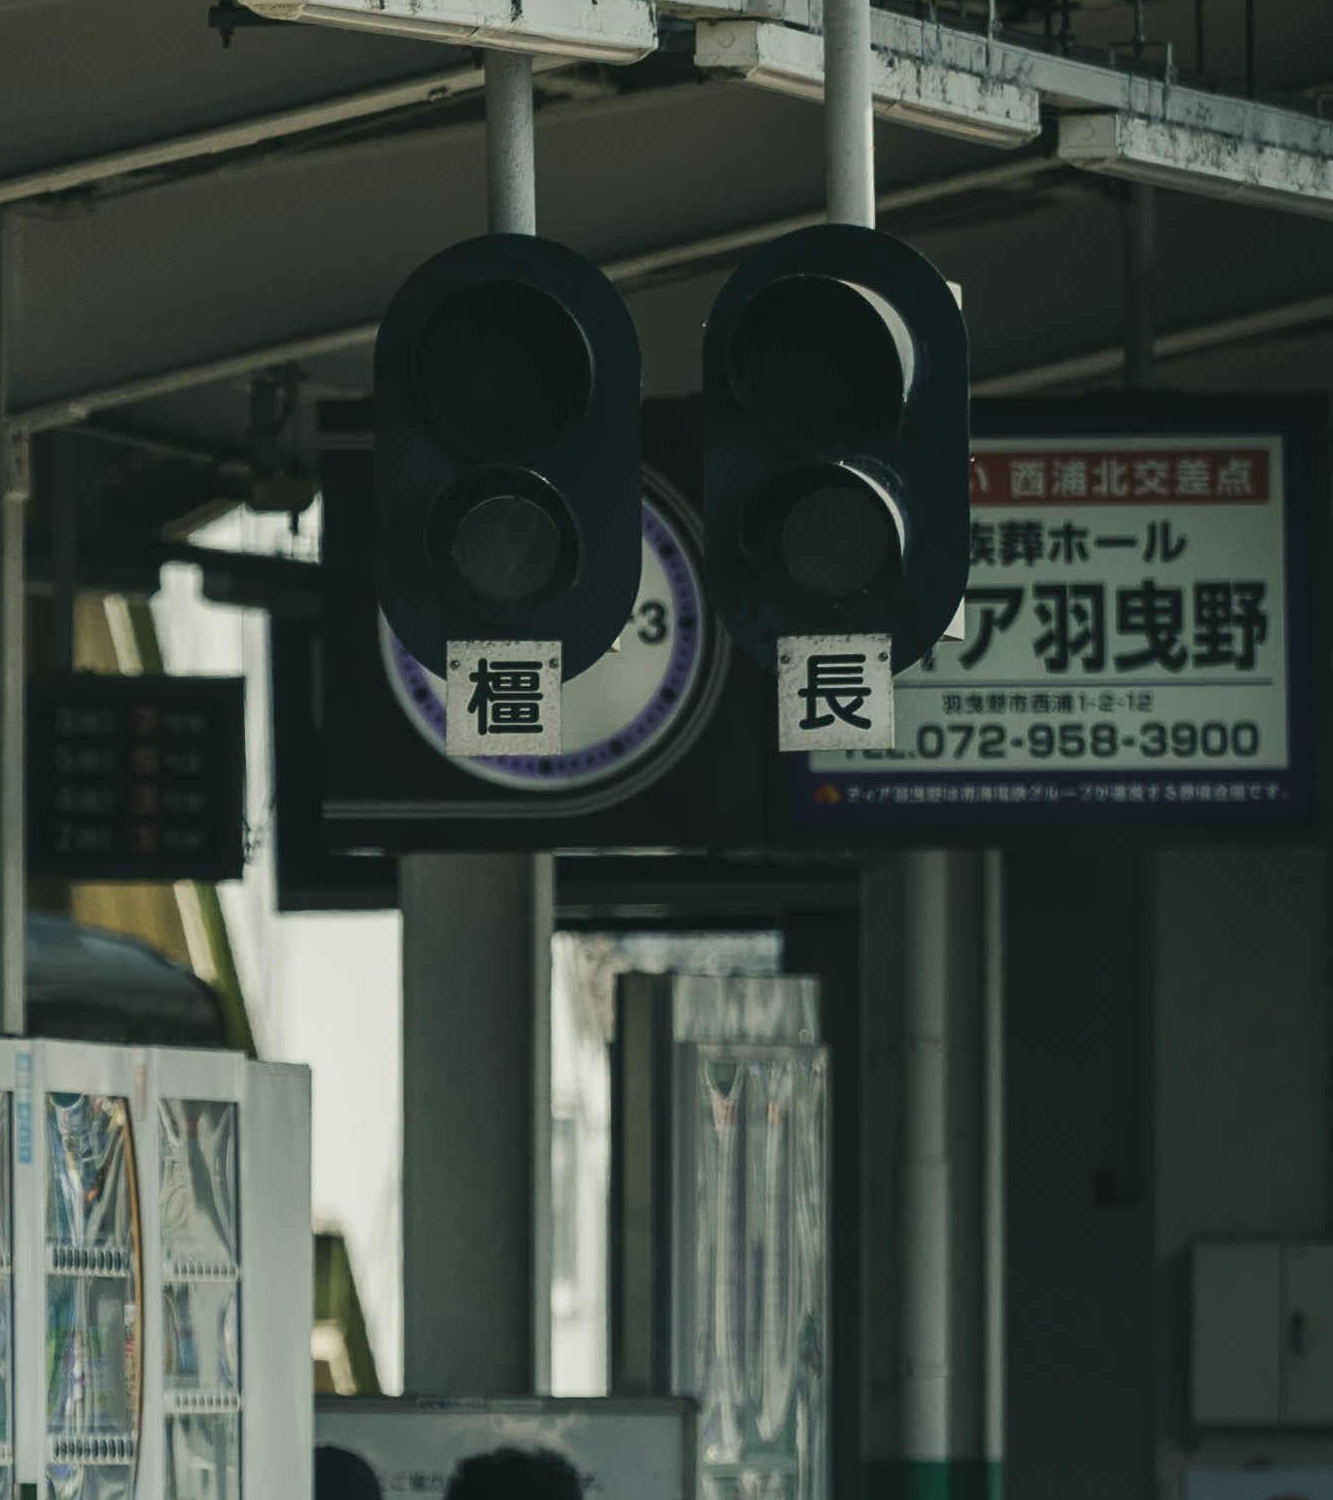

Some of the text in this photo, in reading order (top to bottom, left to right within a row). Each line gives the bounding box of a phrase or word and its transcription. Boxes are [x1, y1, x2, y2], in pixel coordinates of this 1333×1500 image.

[1009, 457, 1253, 498] 西浦北交差点
[921, 576, 1267, 673] ア羽曳野
[467, 657, 544, 736] 橿
[797, 653, 872, 731] 長
